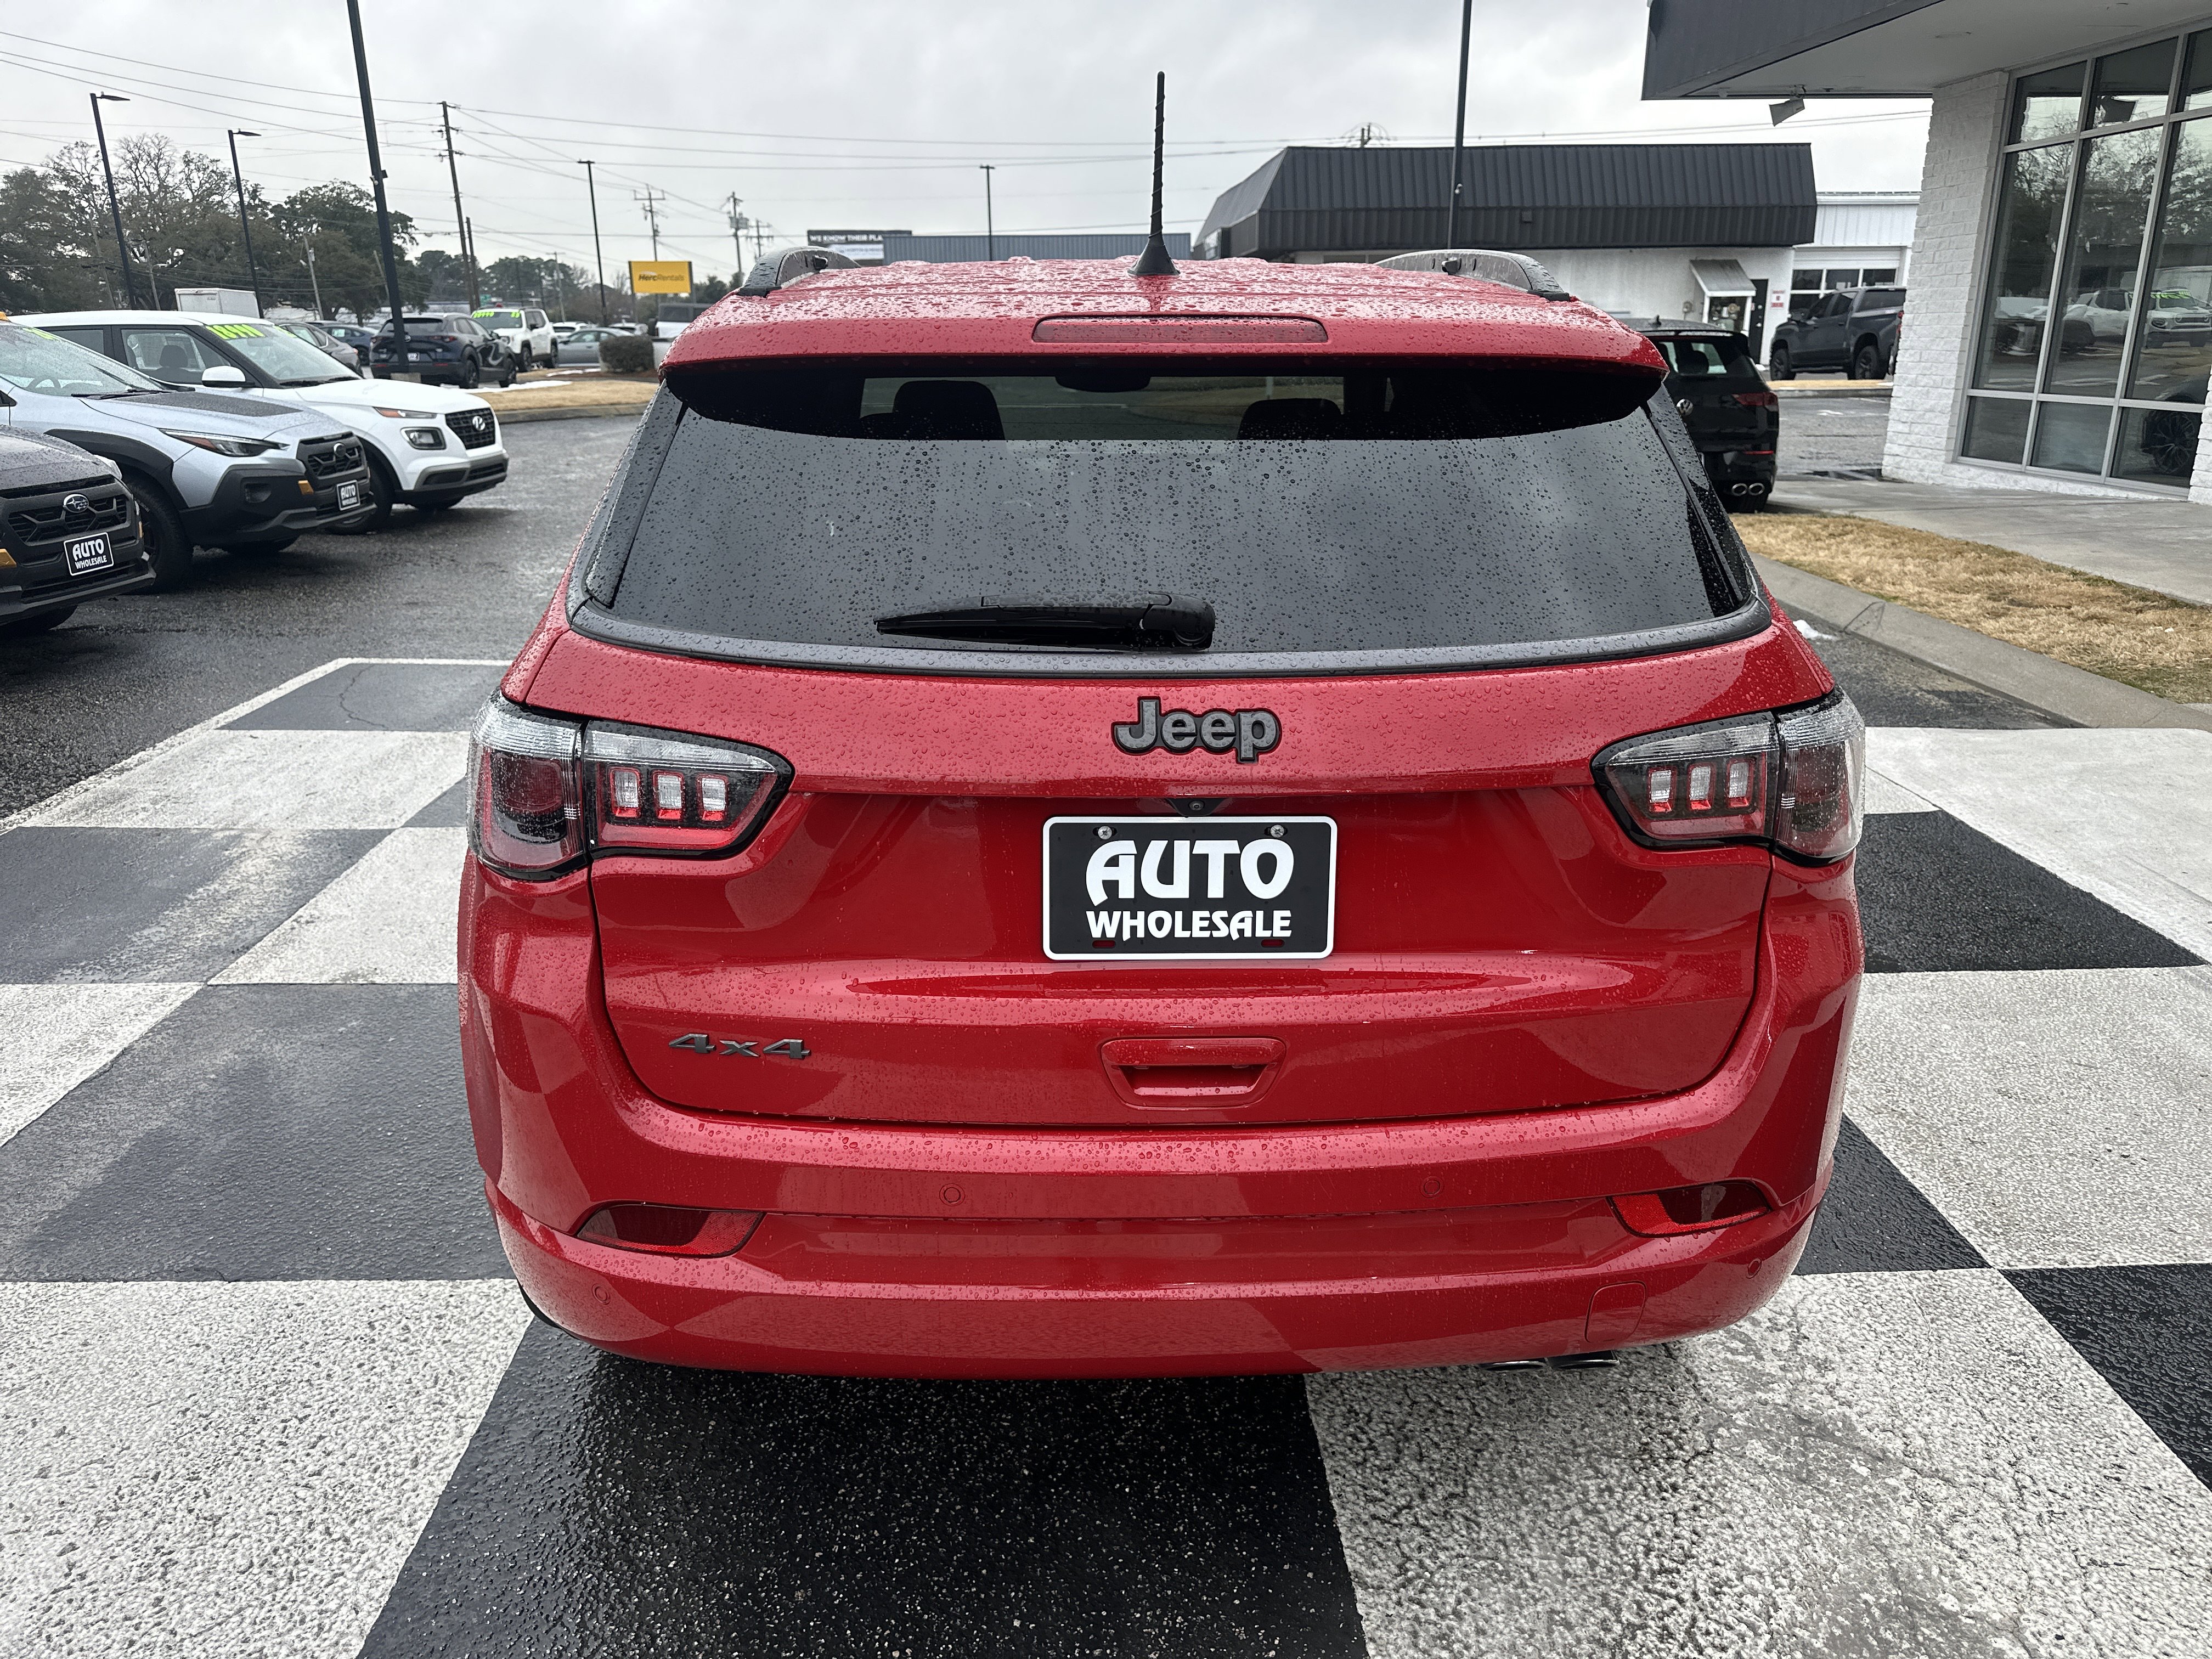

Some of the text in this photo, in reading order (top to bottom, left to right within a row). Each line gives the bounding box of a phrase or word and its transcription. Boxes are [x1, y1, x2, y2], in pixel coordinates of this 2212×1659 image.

[341, 484, 356, 500] AUTO
[72, 539, 104, 561] AUTO
[75, 555, 108, 569] WHOLESALE
[1111, 696, 1282, 763] Jeep
[1085, 838, 1294, 906] AUTO
[1086, 910, 1293, 942] WHOLESALE
[669, 1033, 812, 1060] 4x4
